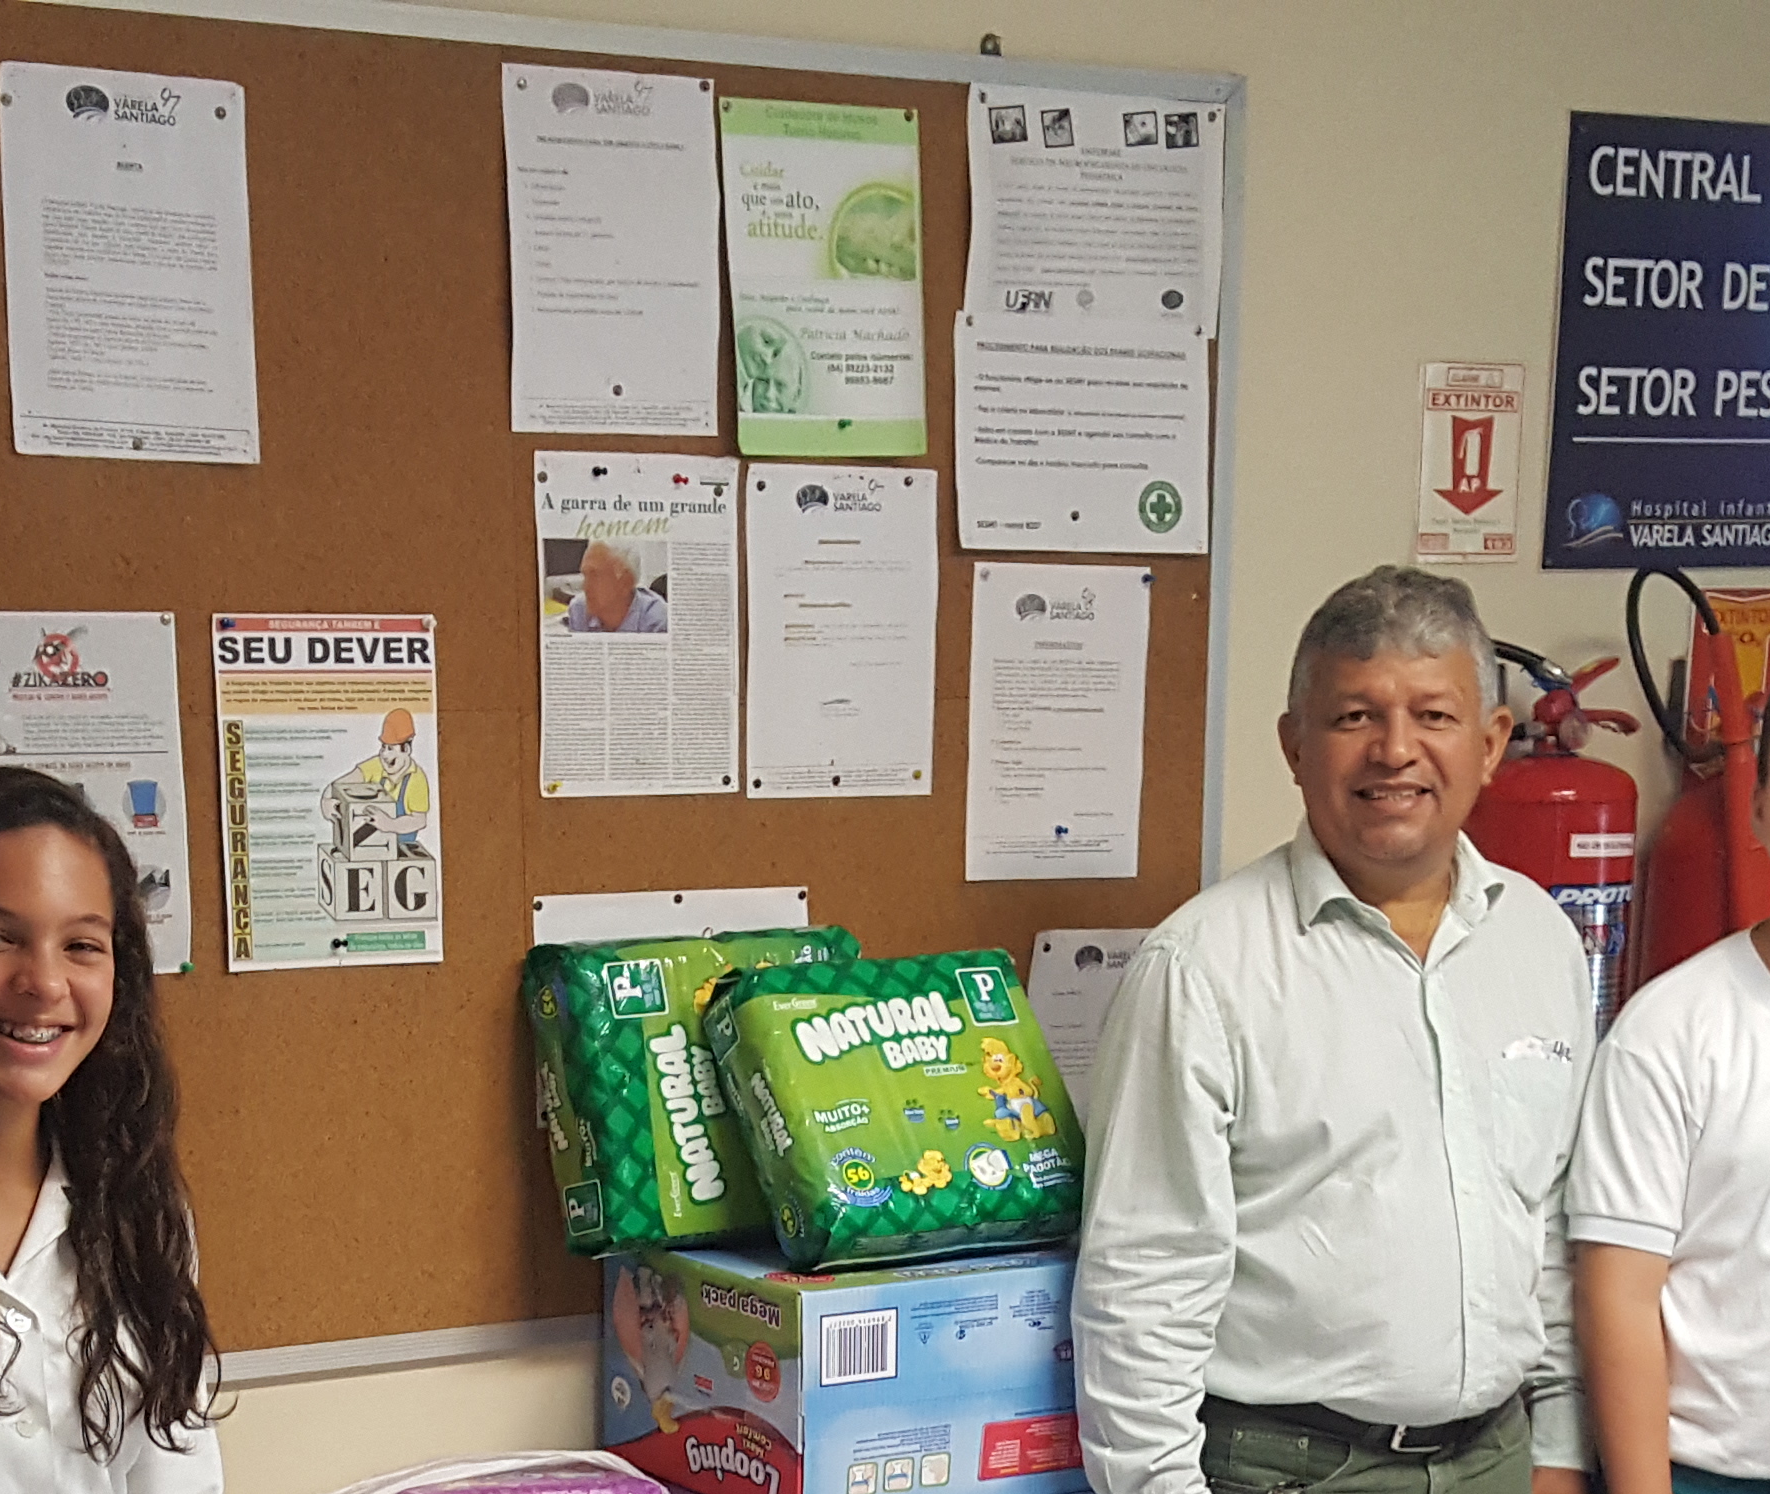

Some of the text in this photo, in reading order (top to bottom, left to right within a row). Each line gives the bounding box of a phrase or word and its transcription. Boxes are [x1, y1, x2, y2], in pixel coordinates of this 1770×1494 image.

[114, 97, 159, 112] VARELA
[114, 109, 177, 126] SANTIAGO
[1590, 145, 1762, 206] CENTRAL
[741, 192, 767, 211] que
[747, 213, 824, 240] atitude.
[1583, 256, 1704, 311] SETOR
[1431, 392, 1515, 409] EXTINTOR
[1577, 366, 1696, 418] SETOR
[1458, 476, 1482, 494] AP
[541, 492, 727, 517] A garra de um grande
[834, 502, 882, 513] SANTIAGO
[1632, 499, 1708, 520] Hospital
[575, 515, 670, 540] homem
[1631, 523, 1696, 548] VARELA
[218, 636, 432, 665] SEU DEVER
[11, 670, 109, 688] #ZIKAZERO
[1559, 885, 1633, 905] PROT
[971, 973, 995, 1001] P
[794, 990, 965, 1064] NATURAL
[881, 1035, 950, 1070] BABY
[690, 1045, 727, 1118] BABY
[649, 1023, 726, 1201] NATURAL
[751, 1071, 794, 1158] NATURAL
[813, 1102, 871, 1124] MUITO+
[824, 1116, 870, 1134] ABSORÇÃO
[1028, 1147, 1060, 1163] MEGA
[845, 1164, 871, 1182] 56
[701, 1282, 782, 1330] Mega pack
[734, 1421, 773, 1451] Comfort
